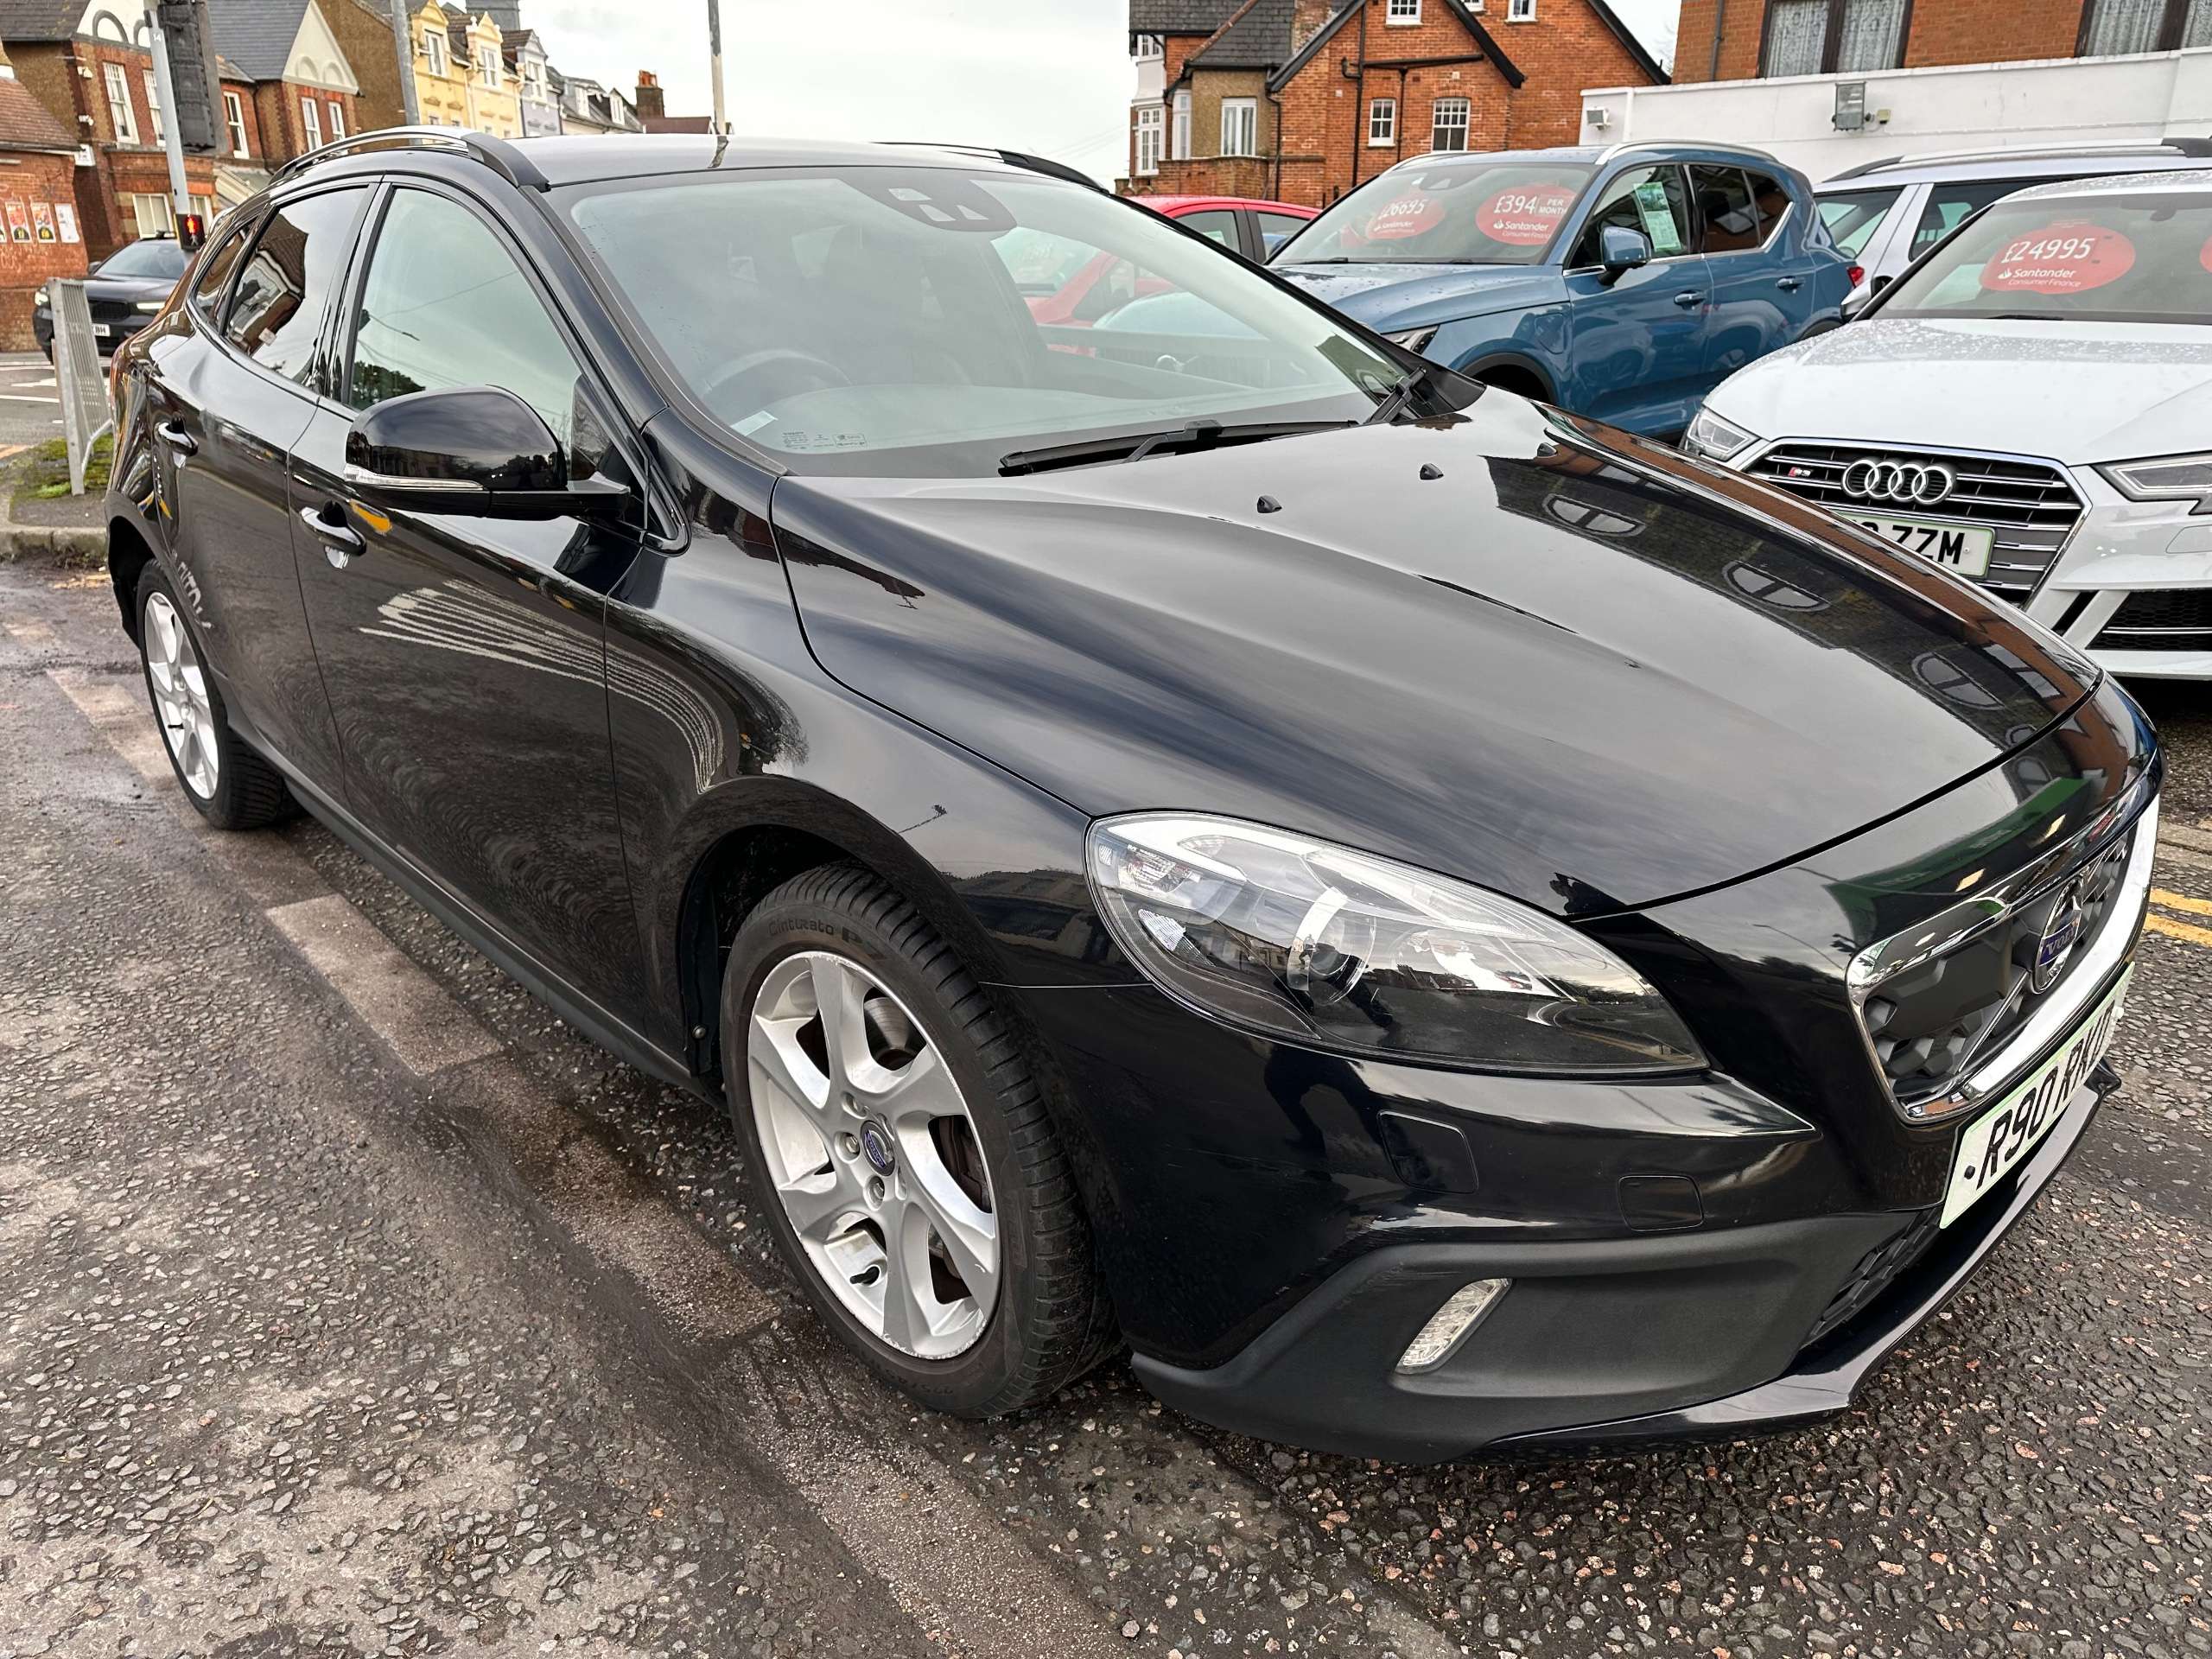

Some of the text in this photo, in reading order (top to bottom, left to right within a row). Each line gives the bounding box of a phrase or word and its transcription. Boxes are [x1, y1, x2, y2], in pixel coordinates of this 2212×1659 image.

[1493, 194, 1537, 214] £394
[1547, 198, 1564, 207] PER
[1504, 220, 1549, 231] Santander
[2000, 238, 2095, 264] £24995
[2012, 268, 2076, 278] Santander
[1976, 1066, 2059, 1191] R90
